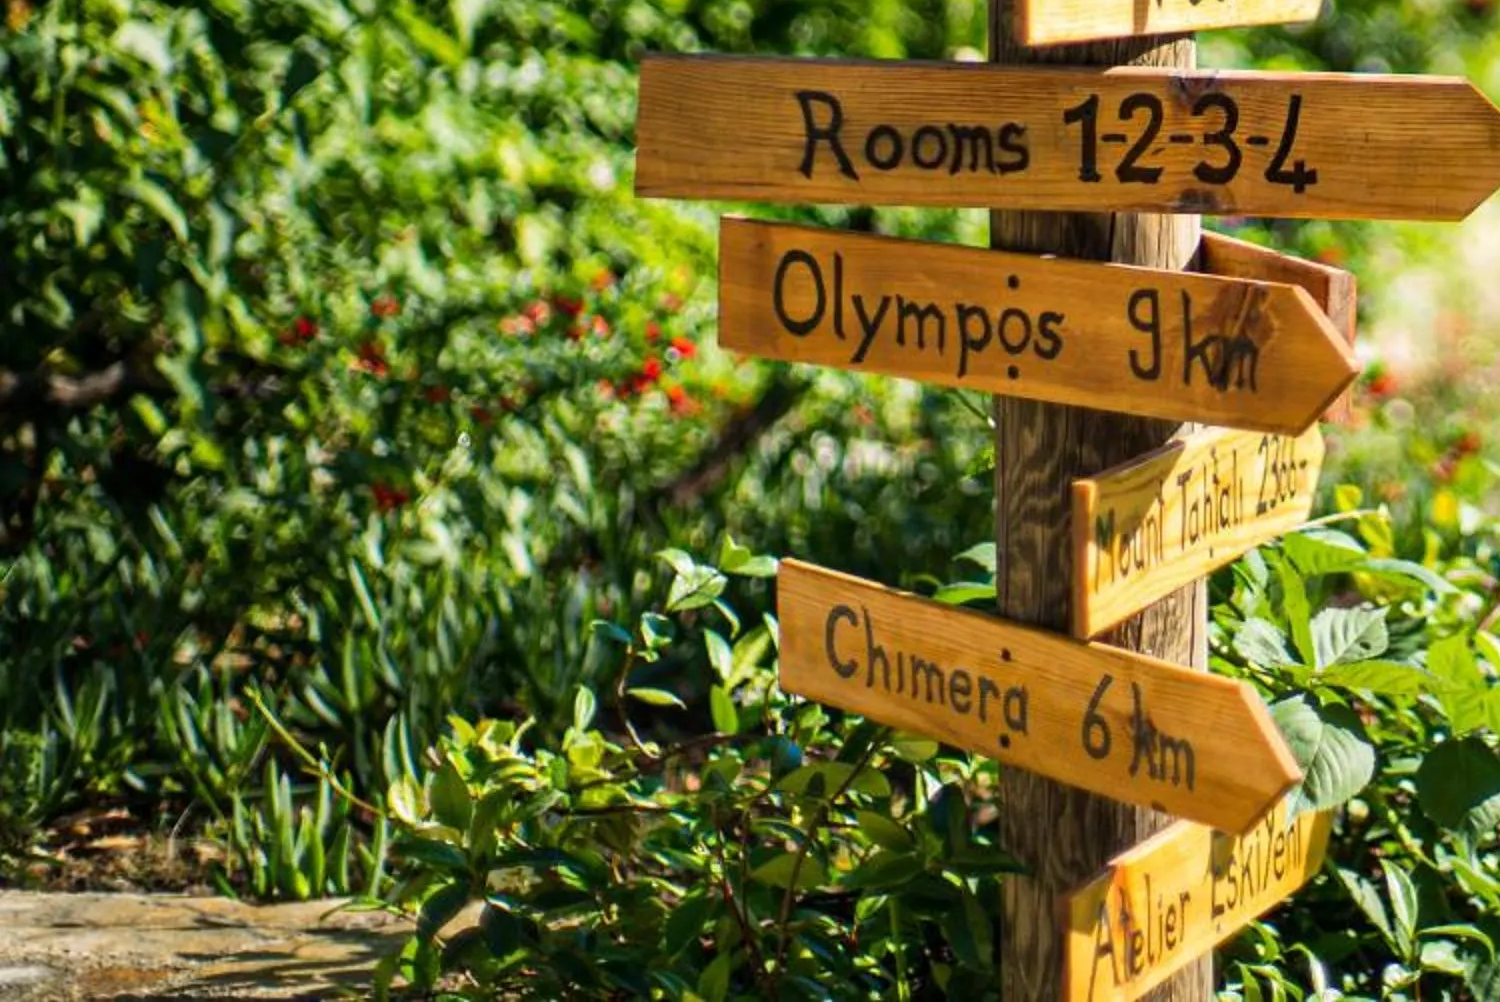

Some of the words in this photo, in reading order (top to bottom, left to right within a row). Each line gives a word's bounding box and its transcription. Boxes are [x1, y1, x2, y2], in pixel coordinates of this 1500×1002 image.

[796, 90, 1030, 180] Rooms
[1062, 92, 1318, 195] 1-2-3-4
[773, 249, 1065, 377] Olympos
[1127, 288, 1161, 382] 9
[1181, 288, 1258, 394] km
[1095, 478, 1165, 595] Mount
[825, 605, 1029, 735] Chimera
[1081, 673, 1114, 760] 6
[1129, 680, 1195, 792] km
